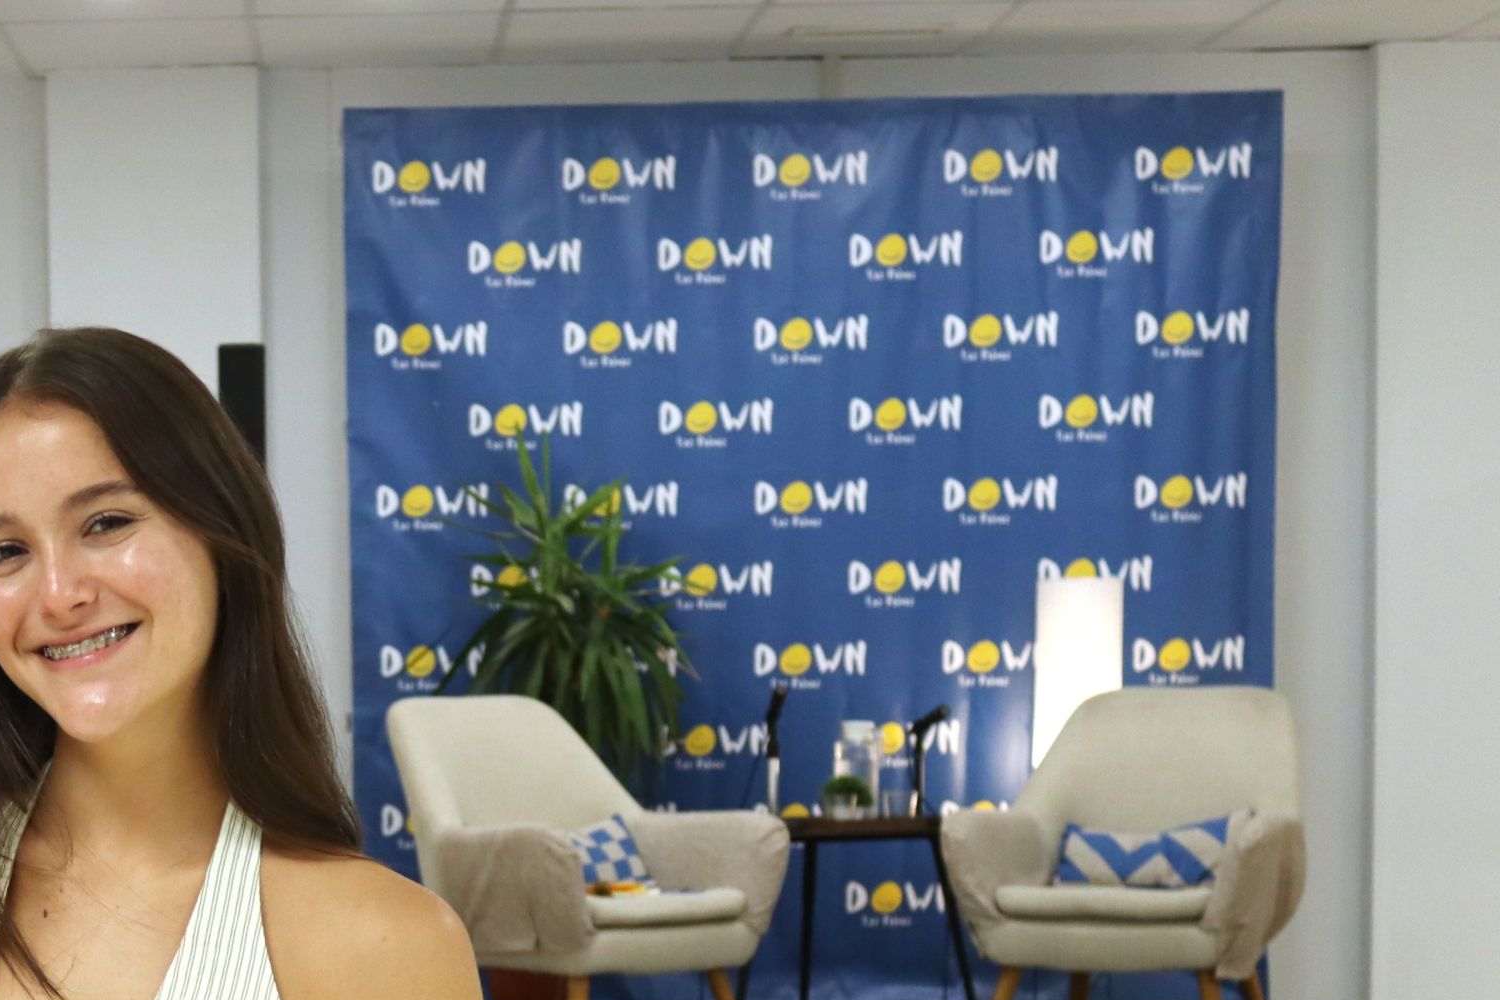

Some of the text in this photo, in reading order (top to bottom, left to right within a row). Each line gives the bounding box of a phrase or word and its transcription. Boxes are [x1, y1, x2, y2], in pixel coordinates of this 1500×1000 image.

[371, 158, 486, 194] DOWN
[561, 155, 677, 191] DOWN
[752, 152, 869, 188] DOWN
[943, 146, 1059, 182] DOWN
[1134, 142, 1252, 178] DOWN
[467, 238, 582, 274] DOWN
[657, 233, 773, 269] DOWN
[848, 230, 964, 266] DOWN
[1039, 227, 1154, 263] DOWN
[374, 320, 488, 356] DOWN
[562, 317, 678, 353] DOWN
[753, 313, 869, 349] DOWN
[942, 310, 1059, 346] DOWN
[1135, 308, 1250, 344] DOWN
[468, 400, 583, 436] DOWN
[658, 397, 774, 433] DOWN
[848, 394, 963, 430] DOWN
[1038, 391, 1154, 427] DOWN
[375, 483, 489, 519] DOWN
[754, 477, 868, 513] DOWN
[942, 474, 1058, 510] DOWN
[1134, 472, 1247, 508] DOWN
[847, 556, 962, 592] DOWN
[754, 639, 868, 675] DOWN
[941, 638, 1033, 675] DOW
[1132, 635, 1246, 671] DOWN
